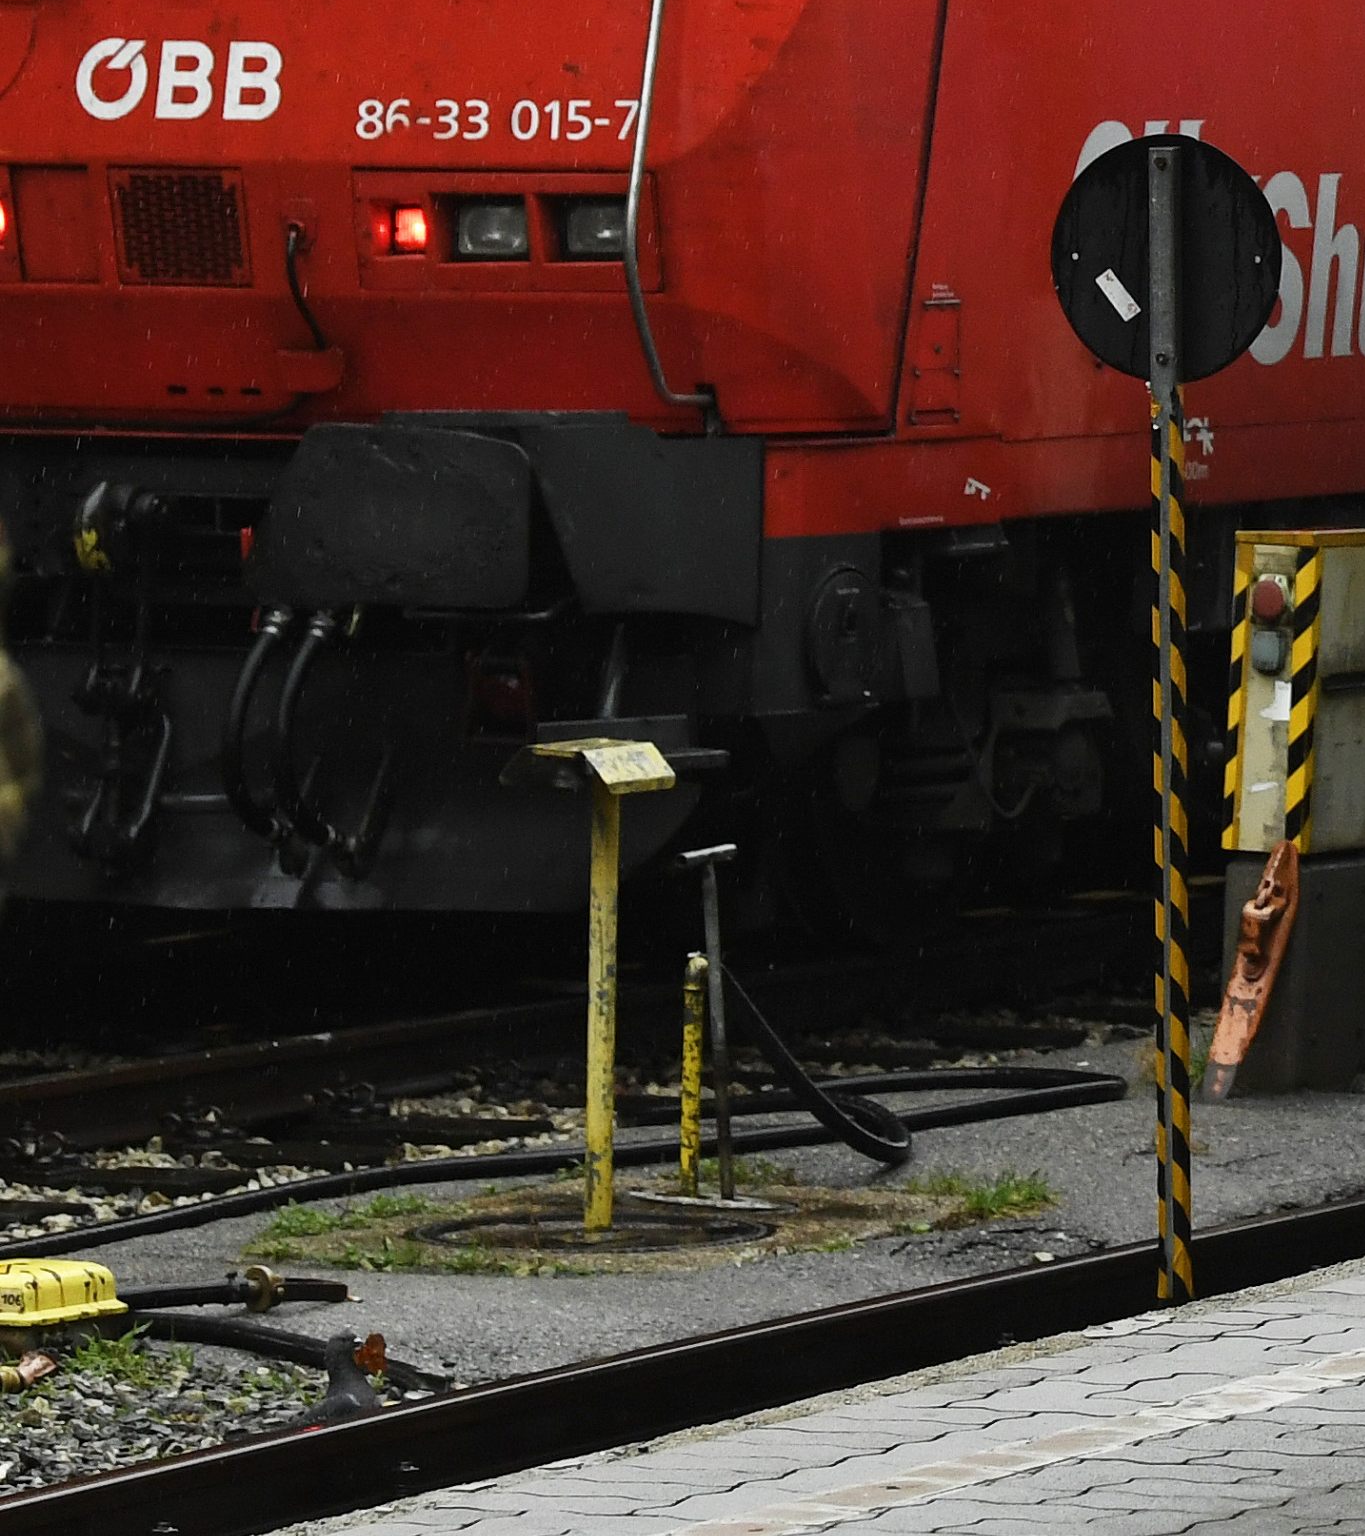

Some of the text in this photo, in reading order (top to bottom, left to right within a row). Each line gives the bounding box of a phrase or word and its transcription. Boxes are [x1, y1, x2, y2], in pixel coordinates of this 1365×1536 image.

[75, 37, 284, 121] ÖBB
[355, 98, 639, 141] 86-33 015-7
